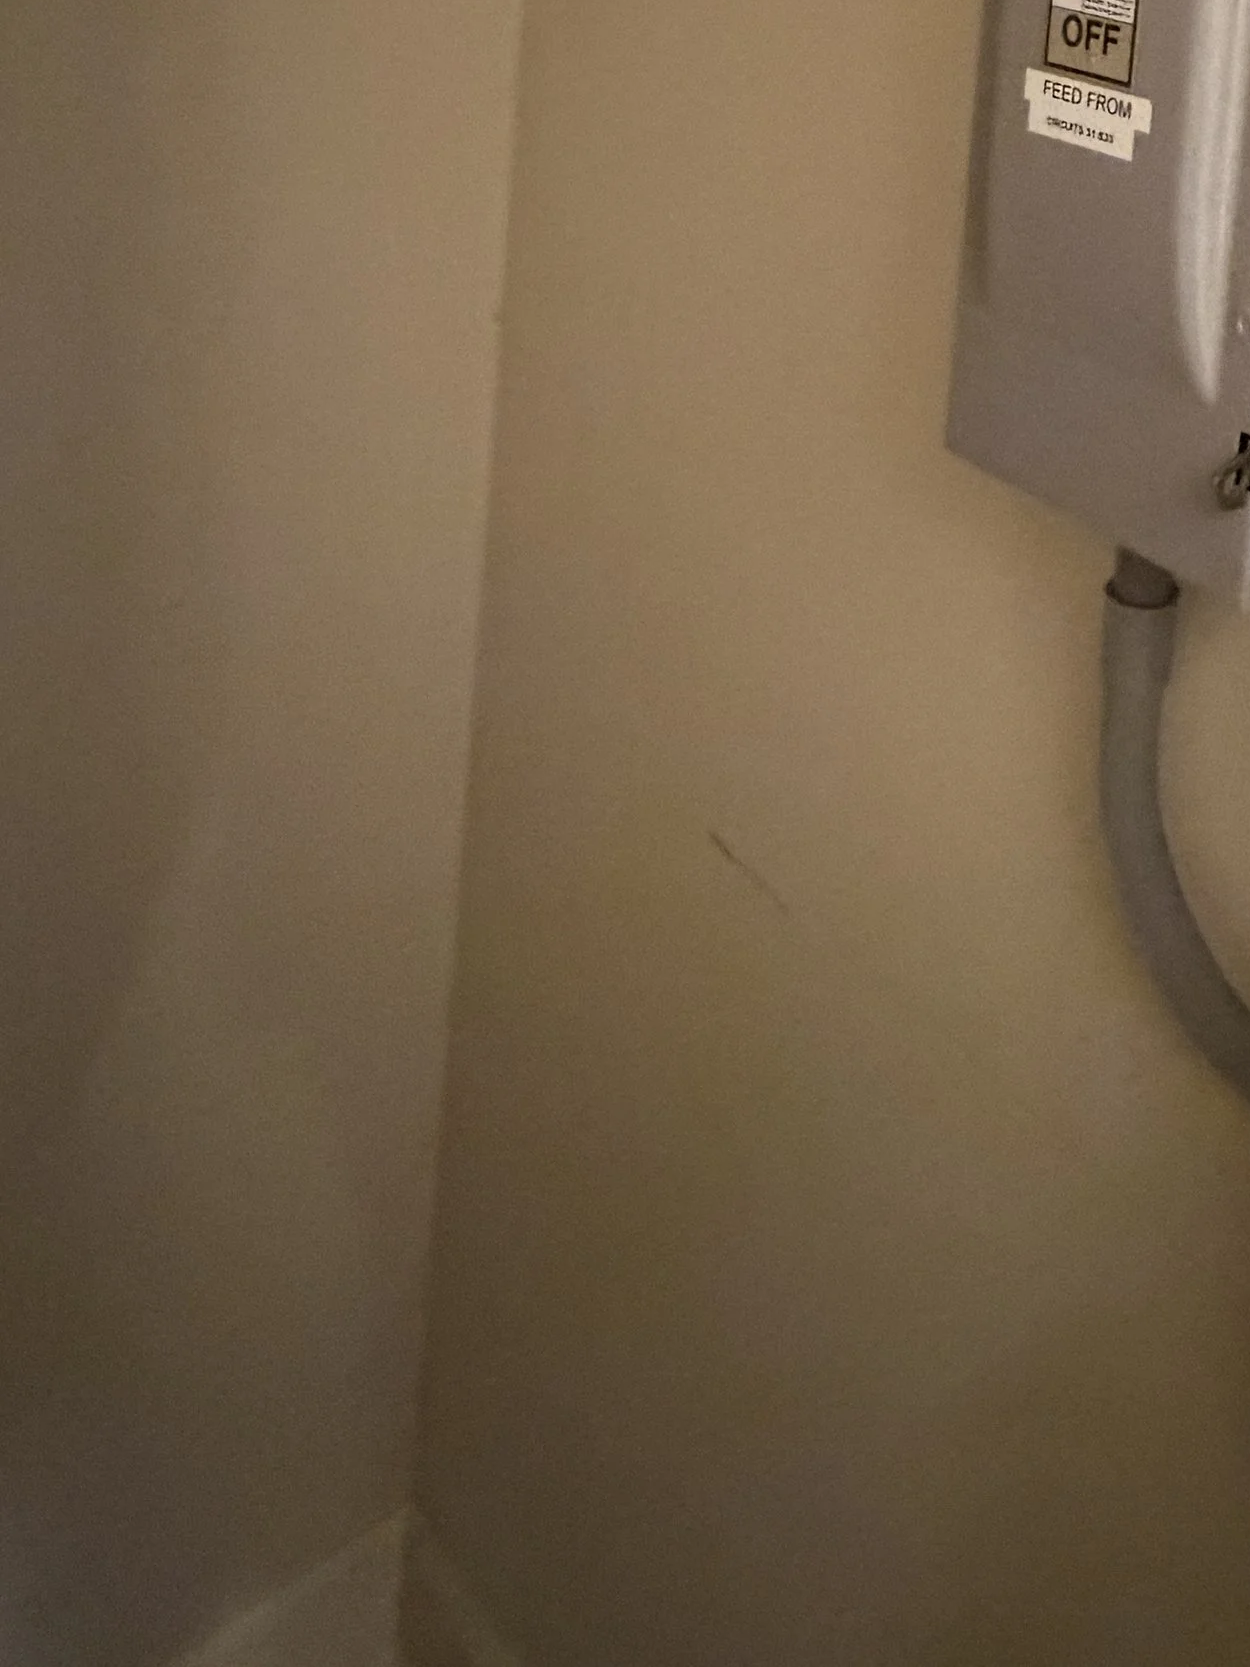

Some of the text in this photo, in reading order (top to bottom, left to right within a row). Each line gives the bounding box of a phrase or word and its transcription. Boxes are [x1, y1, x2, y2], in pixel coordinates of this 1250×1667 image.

[1062, 13, 1121, 55] OFF
[1043, 79, 1132, 120] FEED FROM
